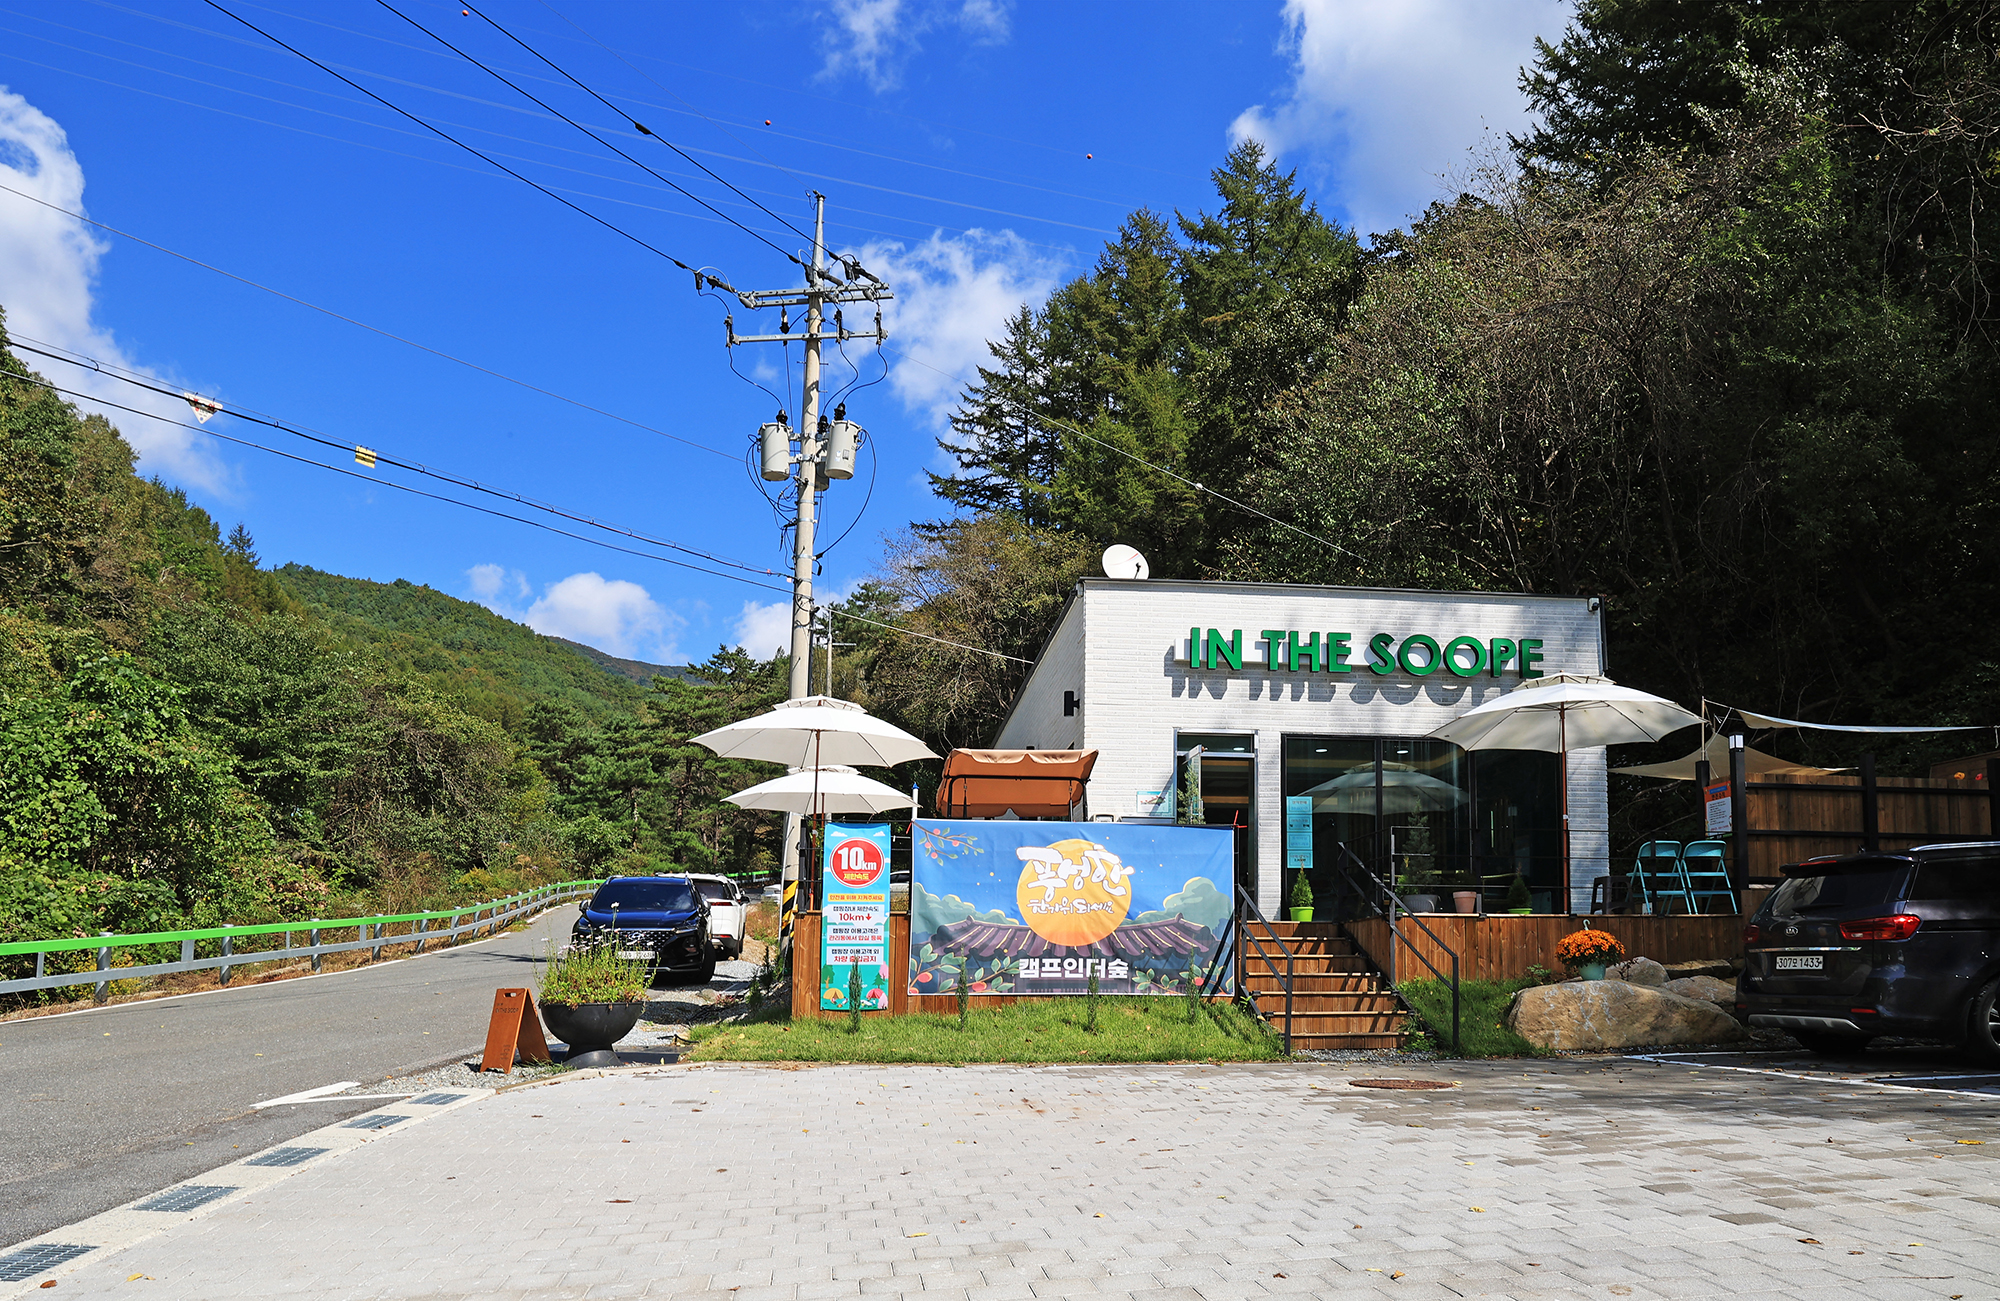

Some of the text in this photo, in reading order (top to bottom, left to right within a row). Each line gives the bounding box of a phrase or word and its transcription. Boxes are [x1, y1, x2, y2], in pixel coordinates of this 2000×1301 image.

[1190, 627, 1545, 679] IN THE SOOPE
[837, 847, 877, 870] 10km
[839, 913, 865, 921] 10km
[834, 955, 848, 963] 차량
[1799, 958, 1820, 968] 1433
[1019, 957, 1129, 979] 캠프인더숲
